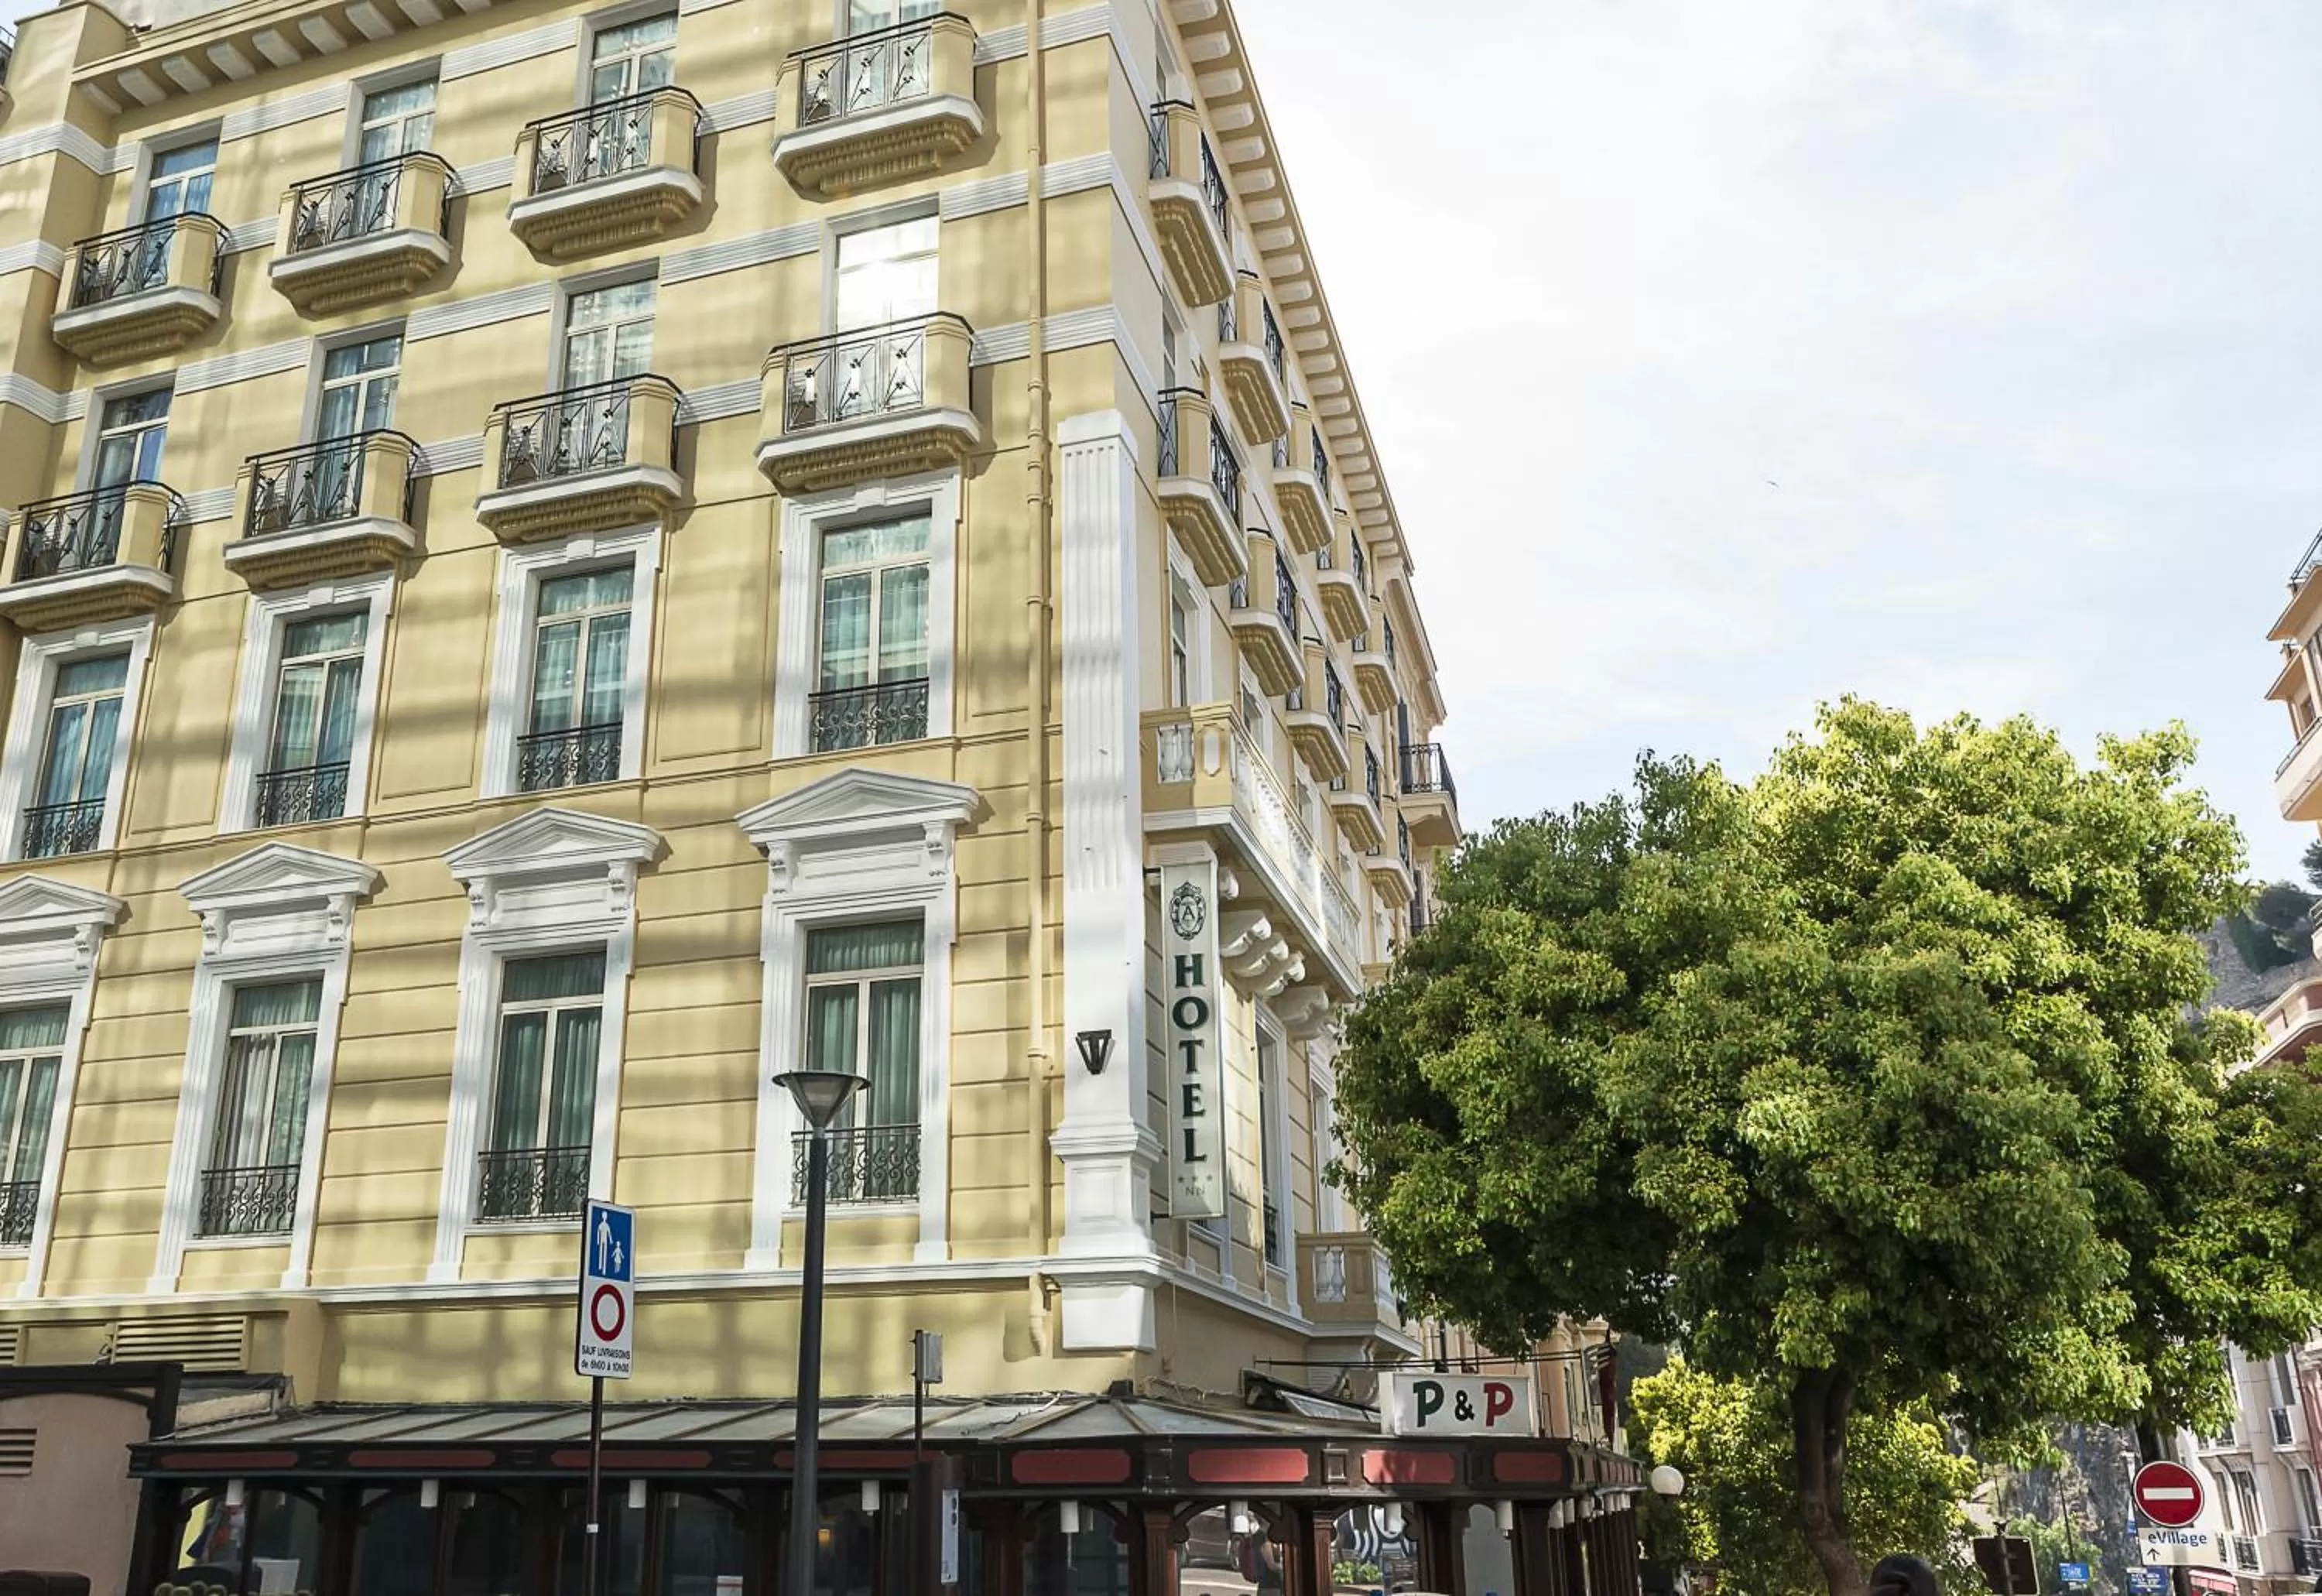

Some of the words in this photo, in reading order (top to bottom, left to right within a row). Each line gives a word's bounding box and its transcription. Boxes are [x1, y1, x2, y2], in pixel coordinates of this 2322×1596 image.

[1173, 954, 1208, 1163] HOTEL
[1413, 1380, 1444, 1427] P
[1454, 1390, 1474, 1421] &
[1484, 1382, 1512, 1426] P
[2148, 1530, 2207, 1547] eVillage
